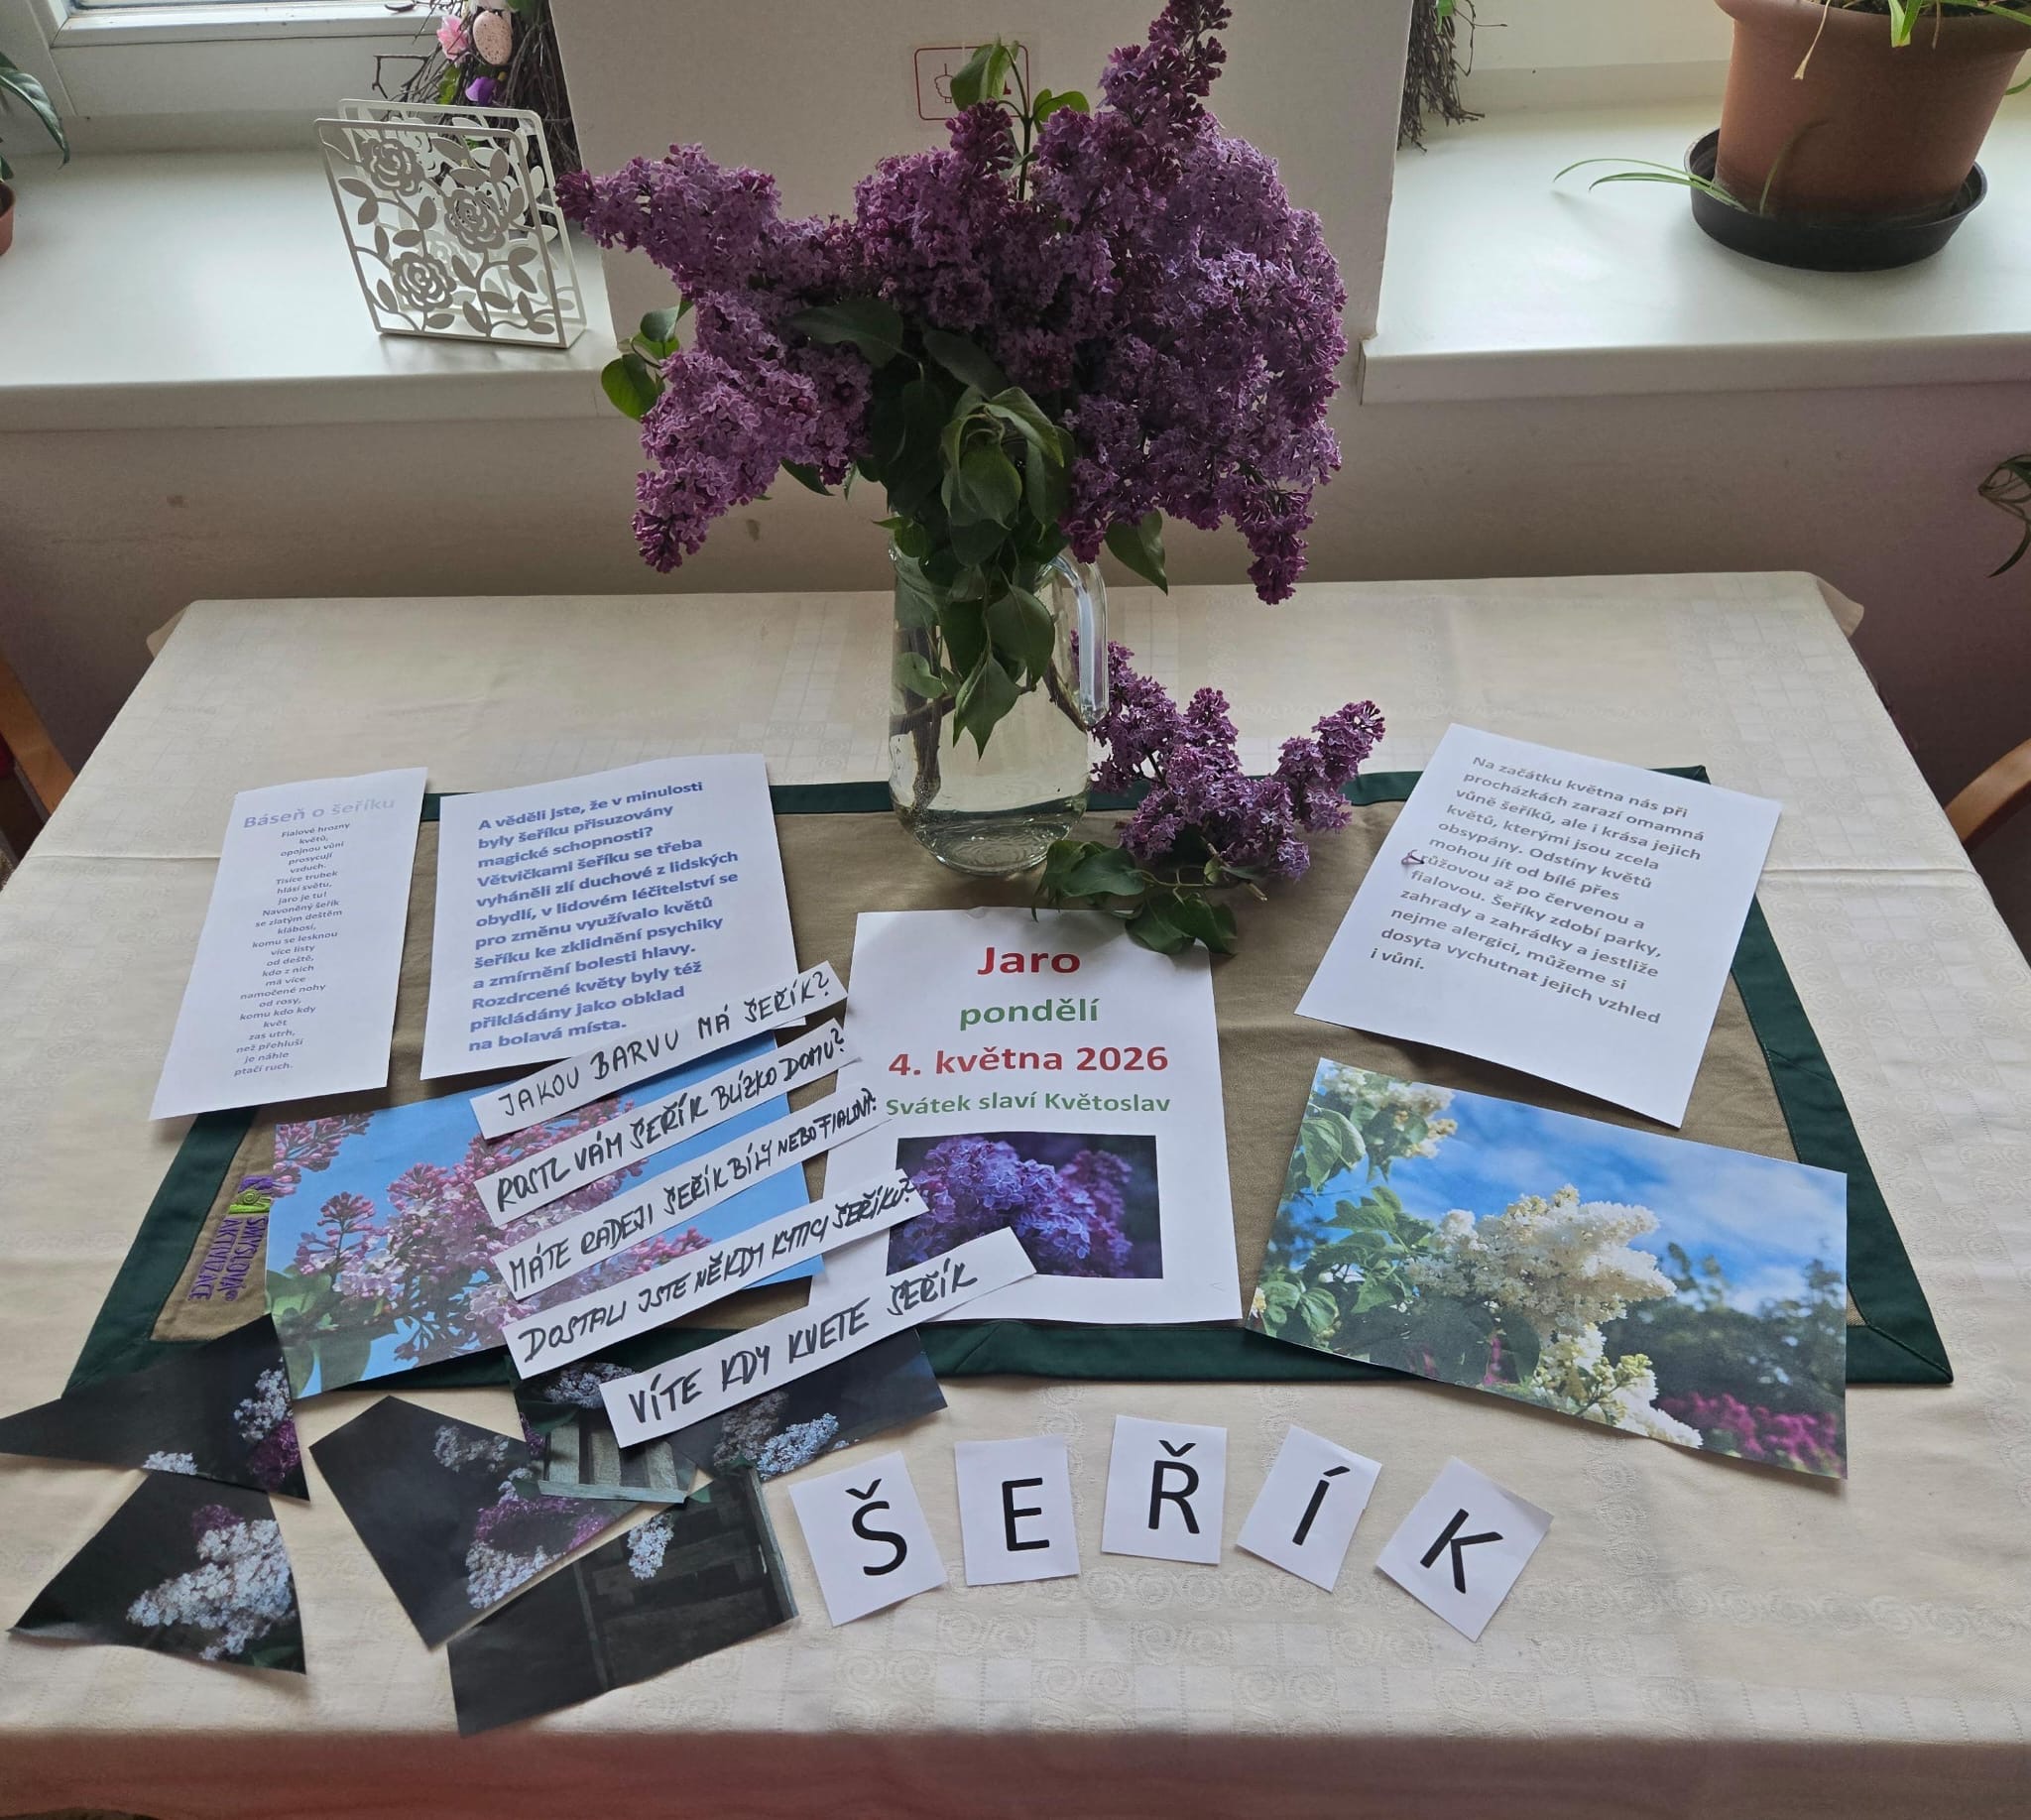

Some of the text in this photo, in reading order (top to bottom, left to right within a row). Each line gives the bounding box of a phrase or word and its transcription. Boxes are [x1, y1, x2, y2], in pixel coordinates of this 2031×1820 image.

[478, 819, 492, 831] A
[495, 809, 546, 827] věděli
[549, 805, 586, 821] jste,
[589, 799, 609, 811] že
[626, 782, 703, 803] minulosti
[1463, 774, 1704, 841] procházkách zarazí omamná
[1473, 757, 1688, 818] Na začátku května nás při
[243, 807, 305, 828] Báseň
[311, 808, 325, 817] o
[478, 805, 673, 849] byly šeříku přisuzovány
[1446, 804, 1659, 870] květů, kterými jsou zcela
[1456, 789, 1701, 861] vůně šeříků, ale i krása jejich
[476, 839, 703, 887] Větvičkami šeříku se třeba
[478, 826, 654, 869] magické schopnosti?
[1429, 839, 1619, 901] mohou jít od bílé přes
[1438, 823, 1652, 889] obsypány. Odstíny květů
[476, 851, 739, 909] vyháněli zlí duchové z lidských
[476, 874, 738, 927] obydlí, v lidovém léčitelství se
[1416, 849, 1644, 929] růžovou až po červenou a
[475, 896, 713, 950] pro změnu využívalo květů
[1400, 891, 1658, 977] zahrady a zahrádky a jestliže
[1406, 863, 1661, 958] fialovou. Šeříky zdobí parky,
[472, 944, 696, 989] a zmírnění bolesti hlavy.
[474, 917, 724, 969] šeříku ke zklidnění psychiky
[978, 947, 1081, 975] Jaro
[1371, 947, 1424, 970] i vůni.
[1390, 910, 1627, 990] nejme alergici, můžeme si
[472, 960, 702, 1010] Rozdrcené květy byly též
[1380, 928, 1661, 1024] dosyta vychutnat jejich vzhled
[468, 1020, 627, 1051] na bolavá místa.
[470, 985, 684, 1033] přikládány jako obklad
[960, 998, 1099, 1031] pondělí
[499, 971, 829, 1117] JAKOU BARVU MÁ ŠEŘÍK?
[889, 1045, 1168, 1076] 4. května 2026
[575, 1133, 623, 1170] VÁM
[630, 1092, 708, 1150] ŠEŘÍK
[711, 1063, 777, 1111] BLÍZKO
[778, 1028, 845, 1082] DOMU?
[886, 1091, 1170, 1116] Svátek slaví Květoslav
[510, 1239, 571, 1291] MÁTE
[663, 1164, 728, 1215] ŠEŘÍK
[777, 1126, 817, 1156] NEBO
[519, 1301, 626, 1363] DOSTALI
[638, 1273, 690, 1314] JSTE
[694, 1242, 764, 1293] NĚKDY
[630, 1258, 978, 1422] VÍTE KDY KVETE ŠEŘÍK
